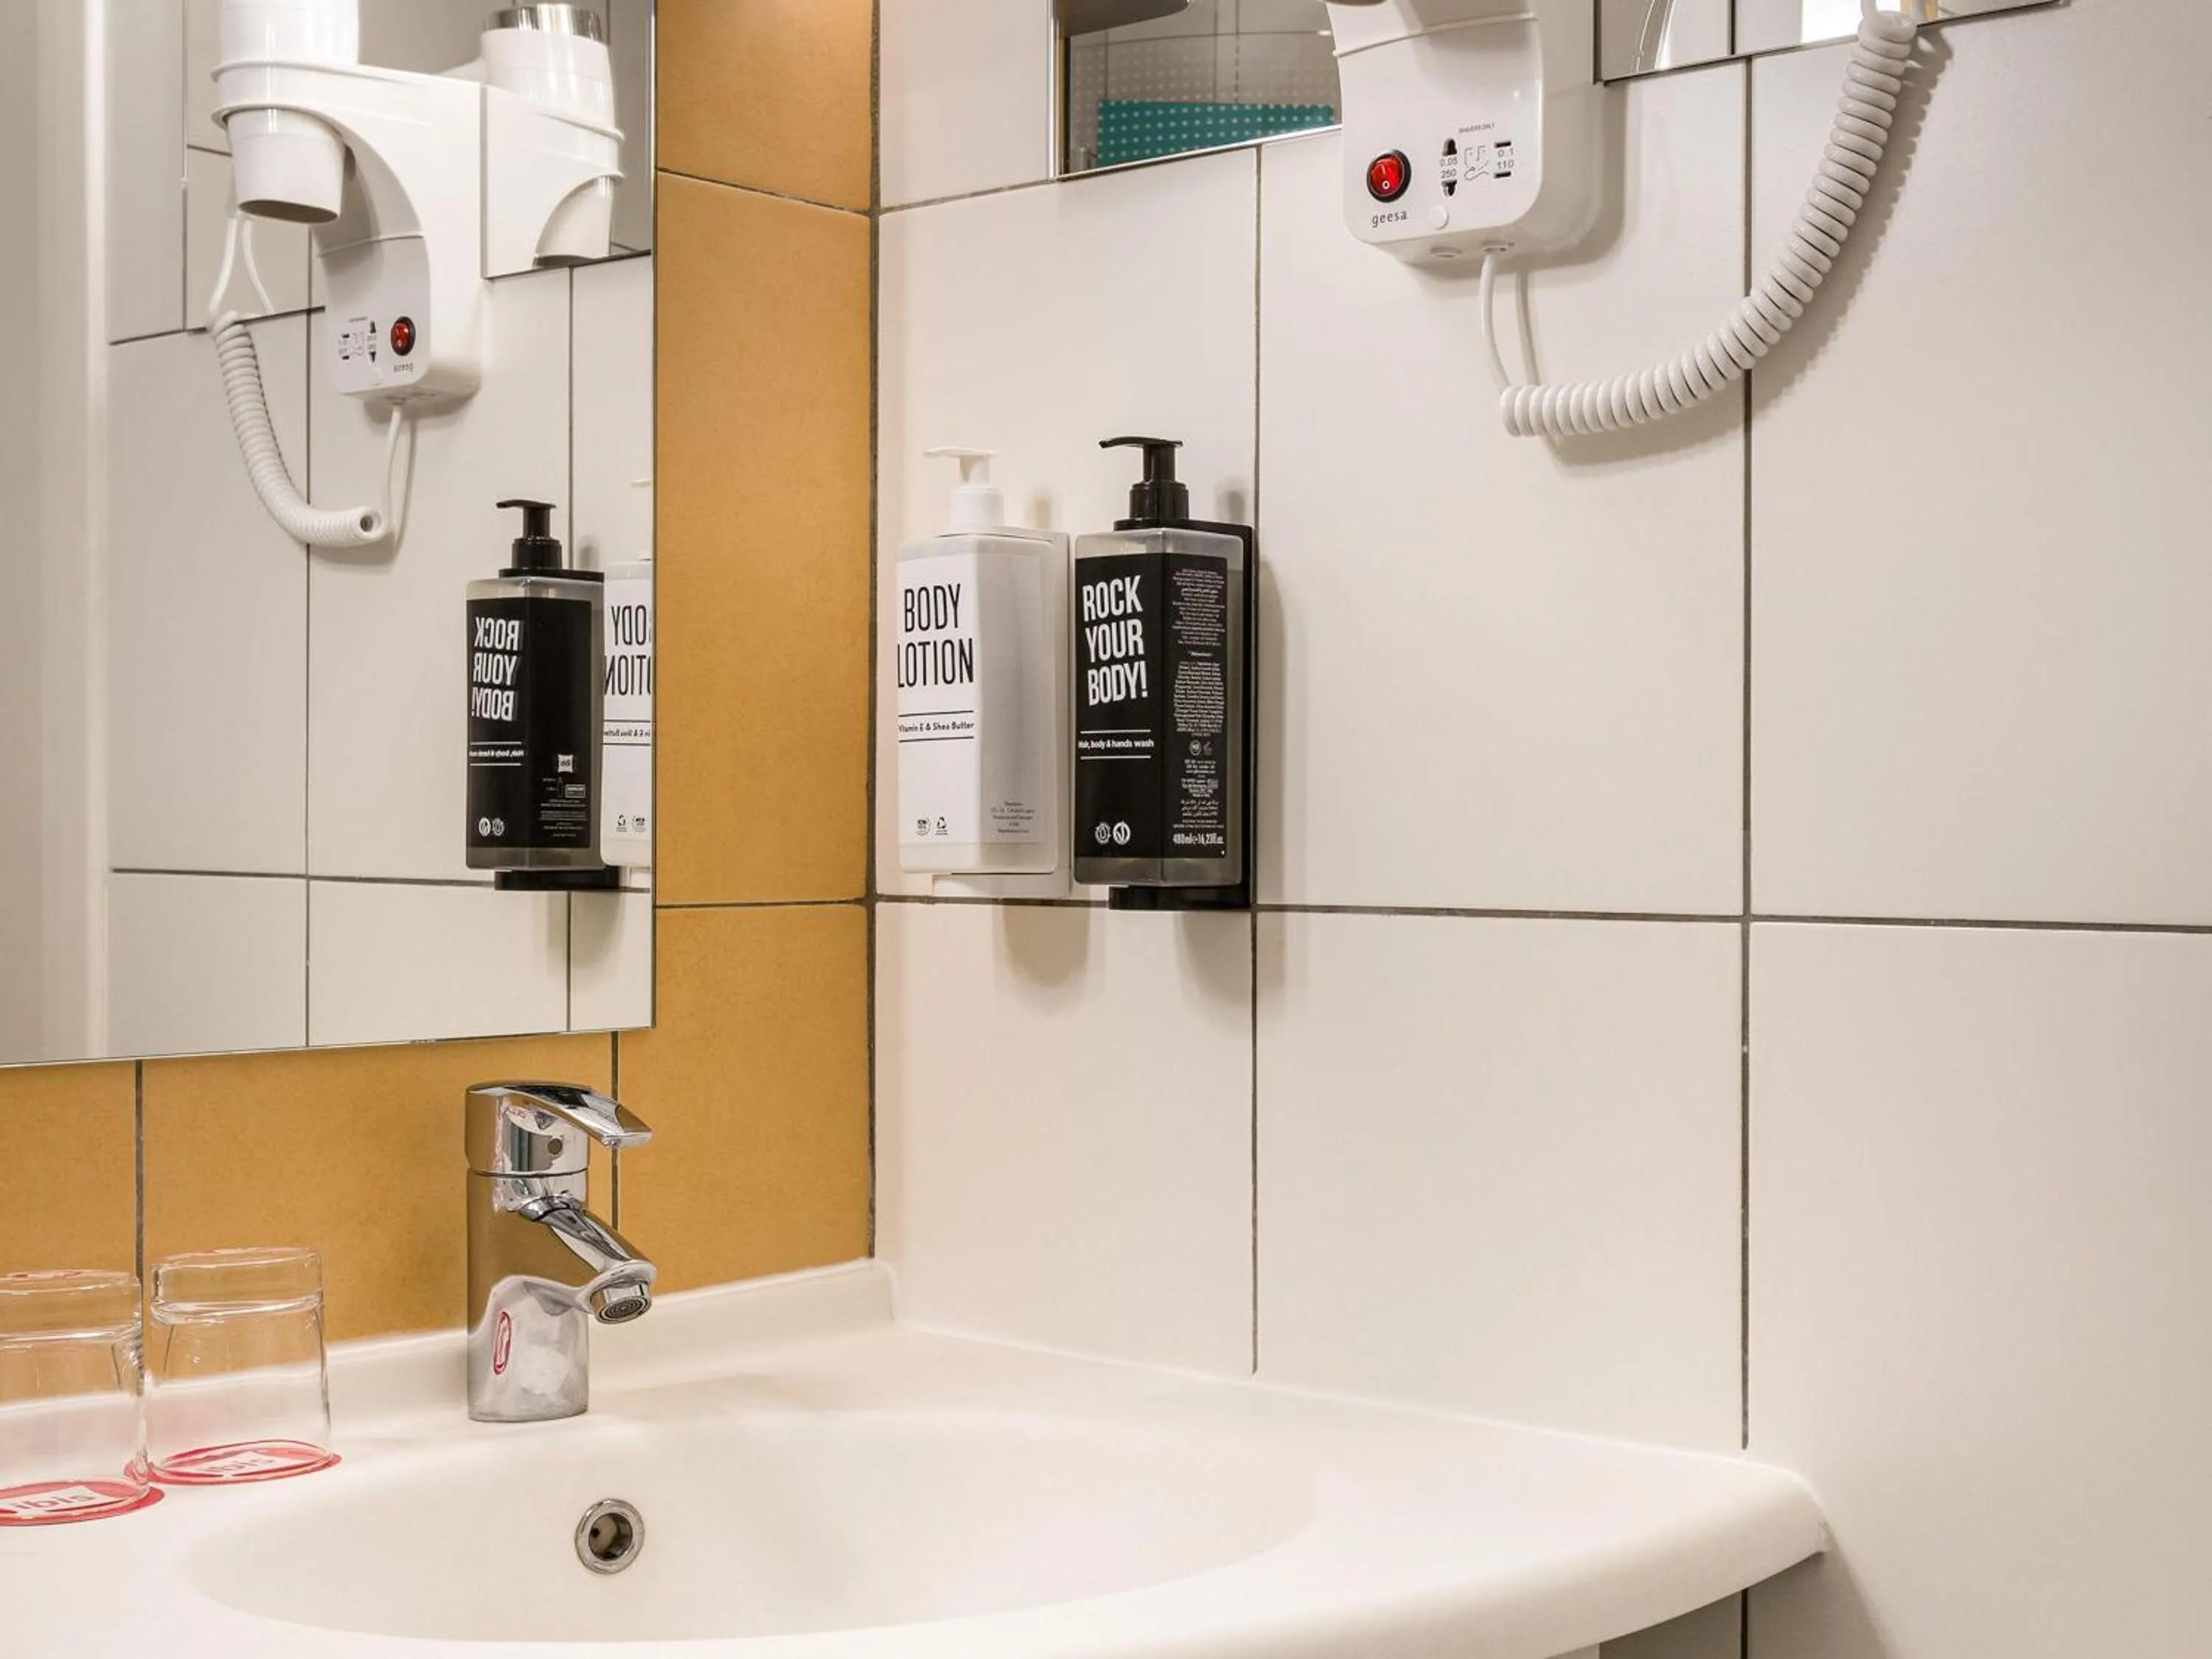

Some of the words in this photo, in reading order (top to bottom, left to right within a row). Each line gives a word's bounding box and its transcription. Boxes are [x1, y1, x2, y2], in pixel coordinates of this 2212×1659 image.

[1439, 157, 1458, 167] 0.05
[1498, 159, 1514, 170] 110
[1441, 169, 1457, 178] 250
[1371, 210, 1408, 228] geesa
[1082, 575, 1143, 622] ROCK
[904, 583, 961, 633] BODY
[1085, 619, 1144, 663] YOUR
[897, 638, 974, 688] LOTION
[1088, 661, 1148, 706] BODY!
[933, 722, 950, 731] Shea
[951, 721, 974, 730] Butter
[1091, 739, 1105, 750] body
[1112, 738, 1133, 748] hands
[1134, 738, 1154, 747] wash
